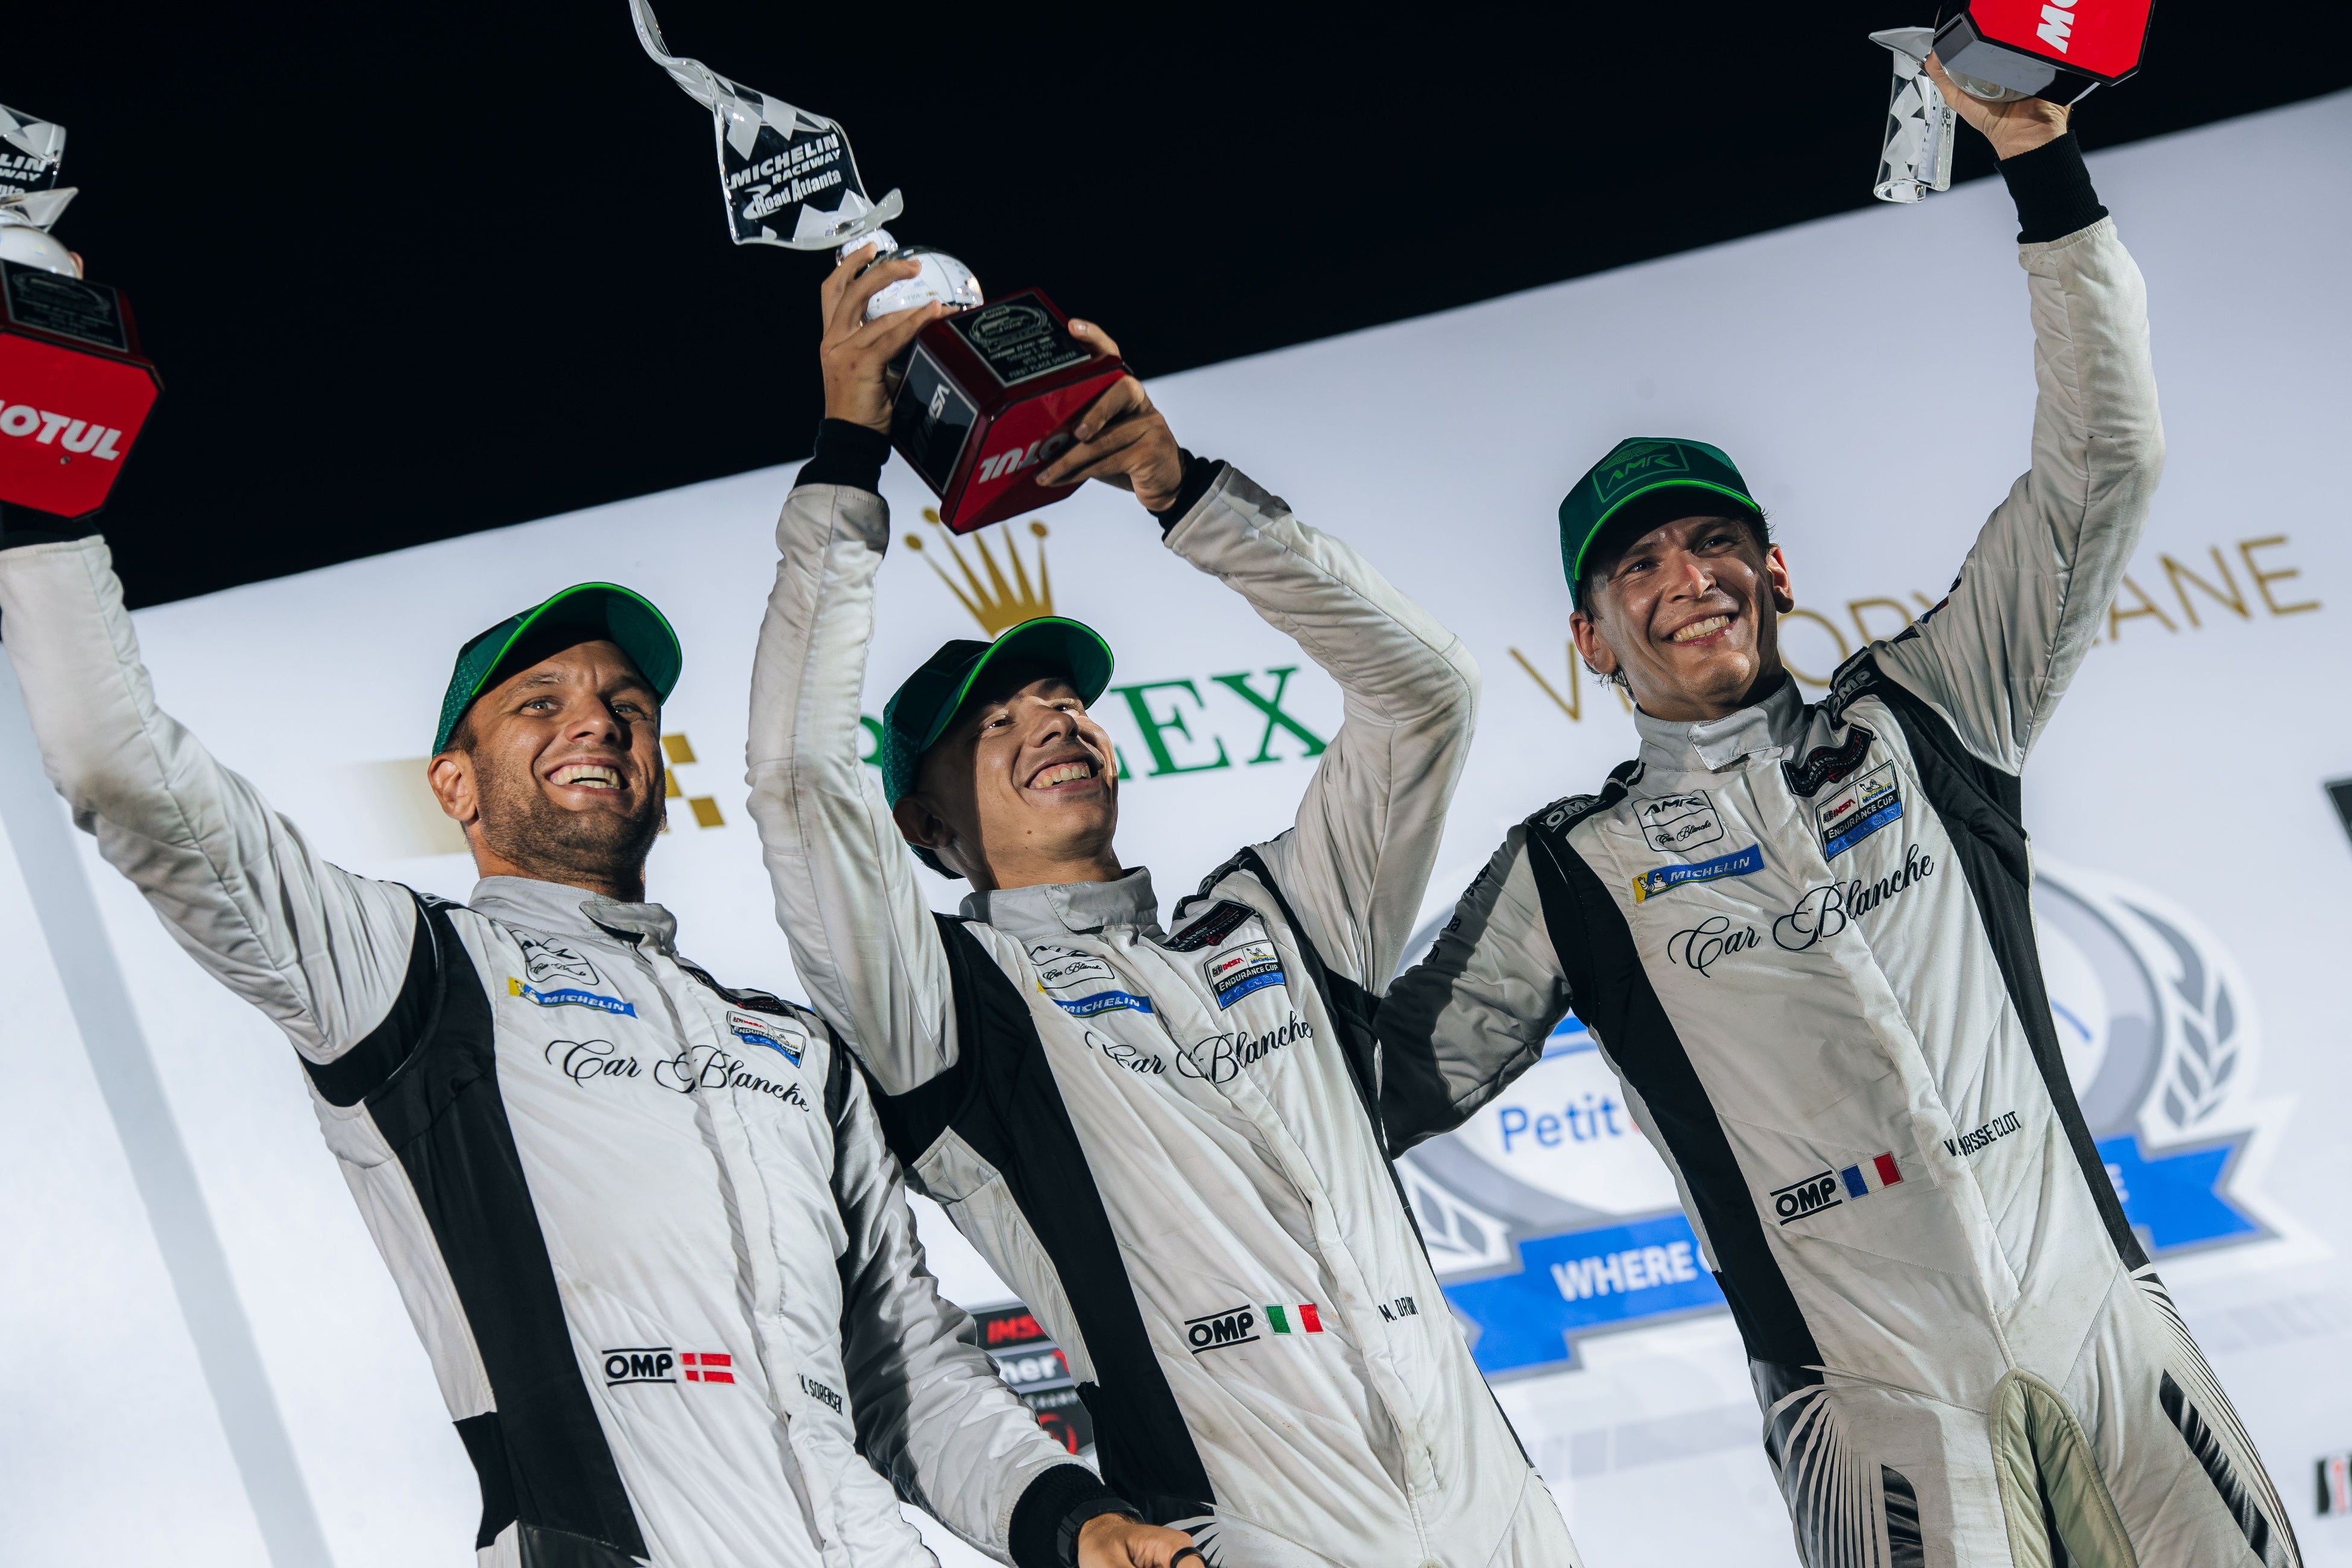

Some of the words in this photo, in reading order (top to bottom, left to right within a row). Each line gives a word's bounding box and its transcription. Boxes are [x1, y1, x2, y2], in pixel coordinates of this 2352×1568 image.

[2036, 0, 2078, 54] M
[728, 133, 839, 190] MICHELIN
[773, 149, 841, 185] RACEWAY
[752, 186, 791, 217] Road
[792, 169, 842, 203] Atlanta
[0, 399, 122, 461] OTUL
[978, 433, 1069, 484] OTUL
[2091, 534, 2322, 646] ANE
[1828, 805, 1877, 839] ENDURANCE
[1877, 794, 1895, 812] CUP
[1670, 856, 1750, 882] MICHELIN
[1668, 915, 1763, 978] Car
[1772, 844, 1935, 951] Blanche
[1219, 966, 1265, 992] ENDURANCE
[544, 994, 625, 1012] MICHELIN
[1062, 996, 1140, 1014] MICHELIN
[733, 1026, 778, 1043] ENDURAN
[1086, 1030, 1166, 1075] Car
[1176, 1010, 1314, 1085] Blanche
[546, 1039, 642, 1089] Car
[654, 1045, 811, 1113] Blanche
[1498, 1093, 1624, 1152] Petit
[1992, 1110, 2022, 1138] CLOT
[1775, 1177, 1837, 1218] OMP
[1551, 1241, 1698, 1303] WHERE
[1188, 1311, 1254, 1348] OMP
[605, 1353, 674, 1379] OMP
